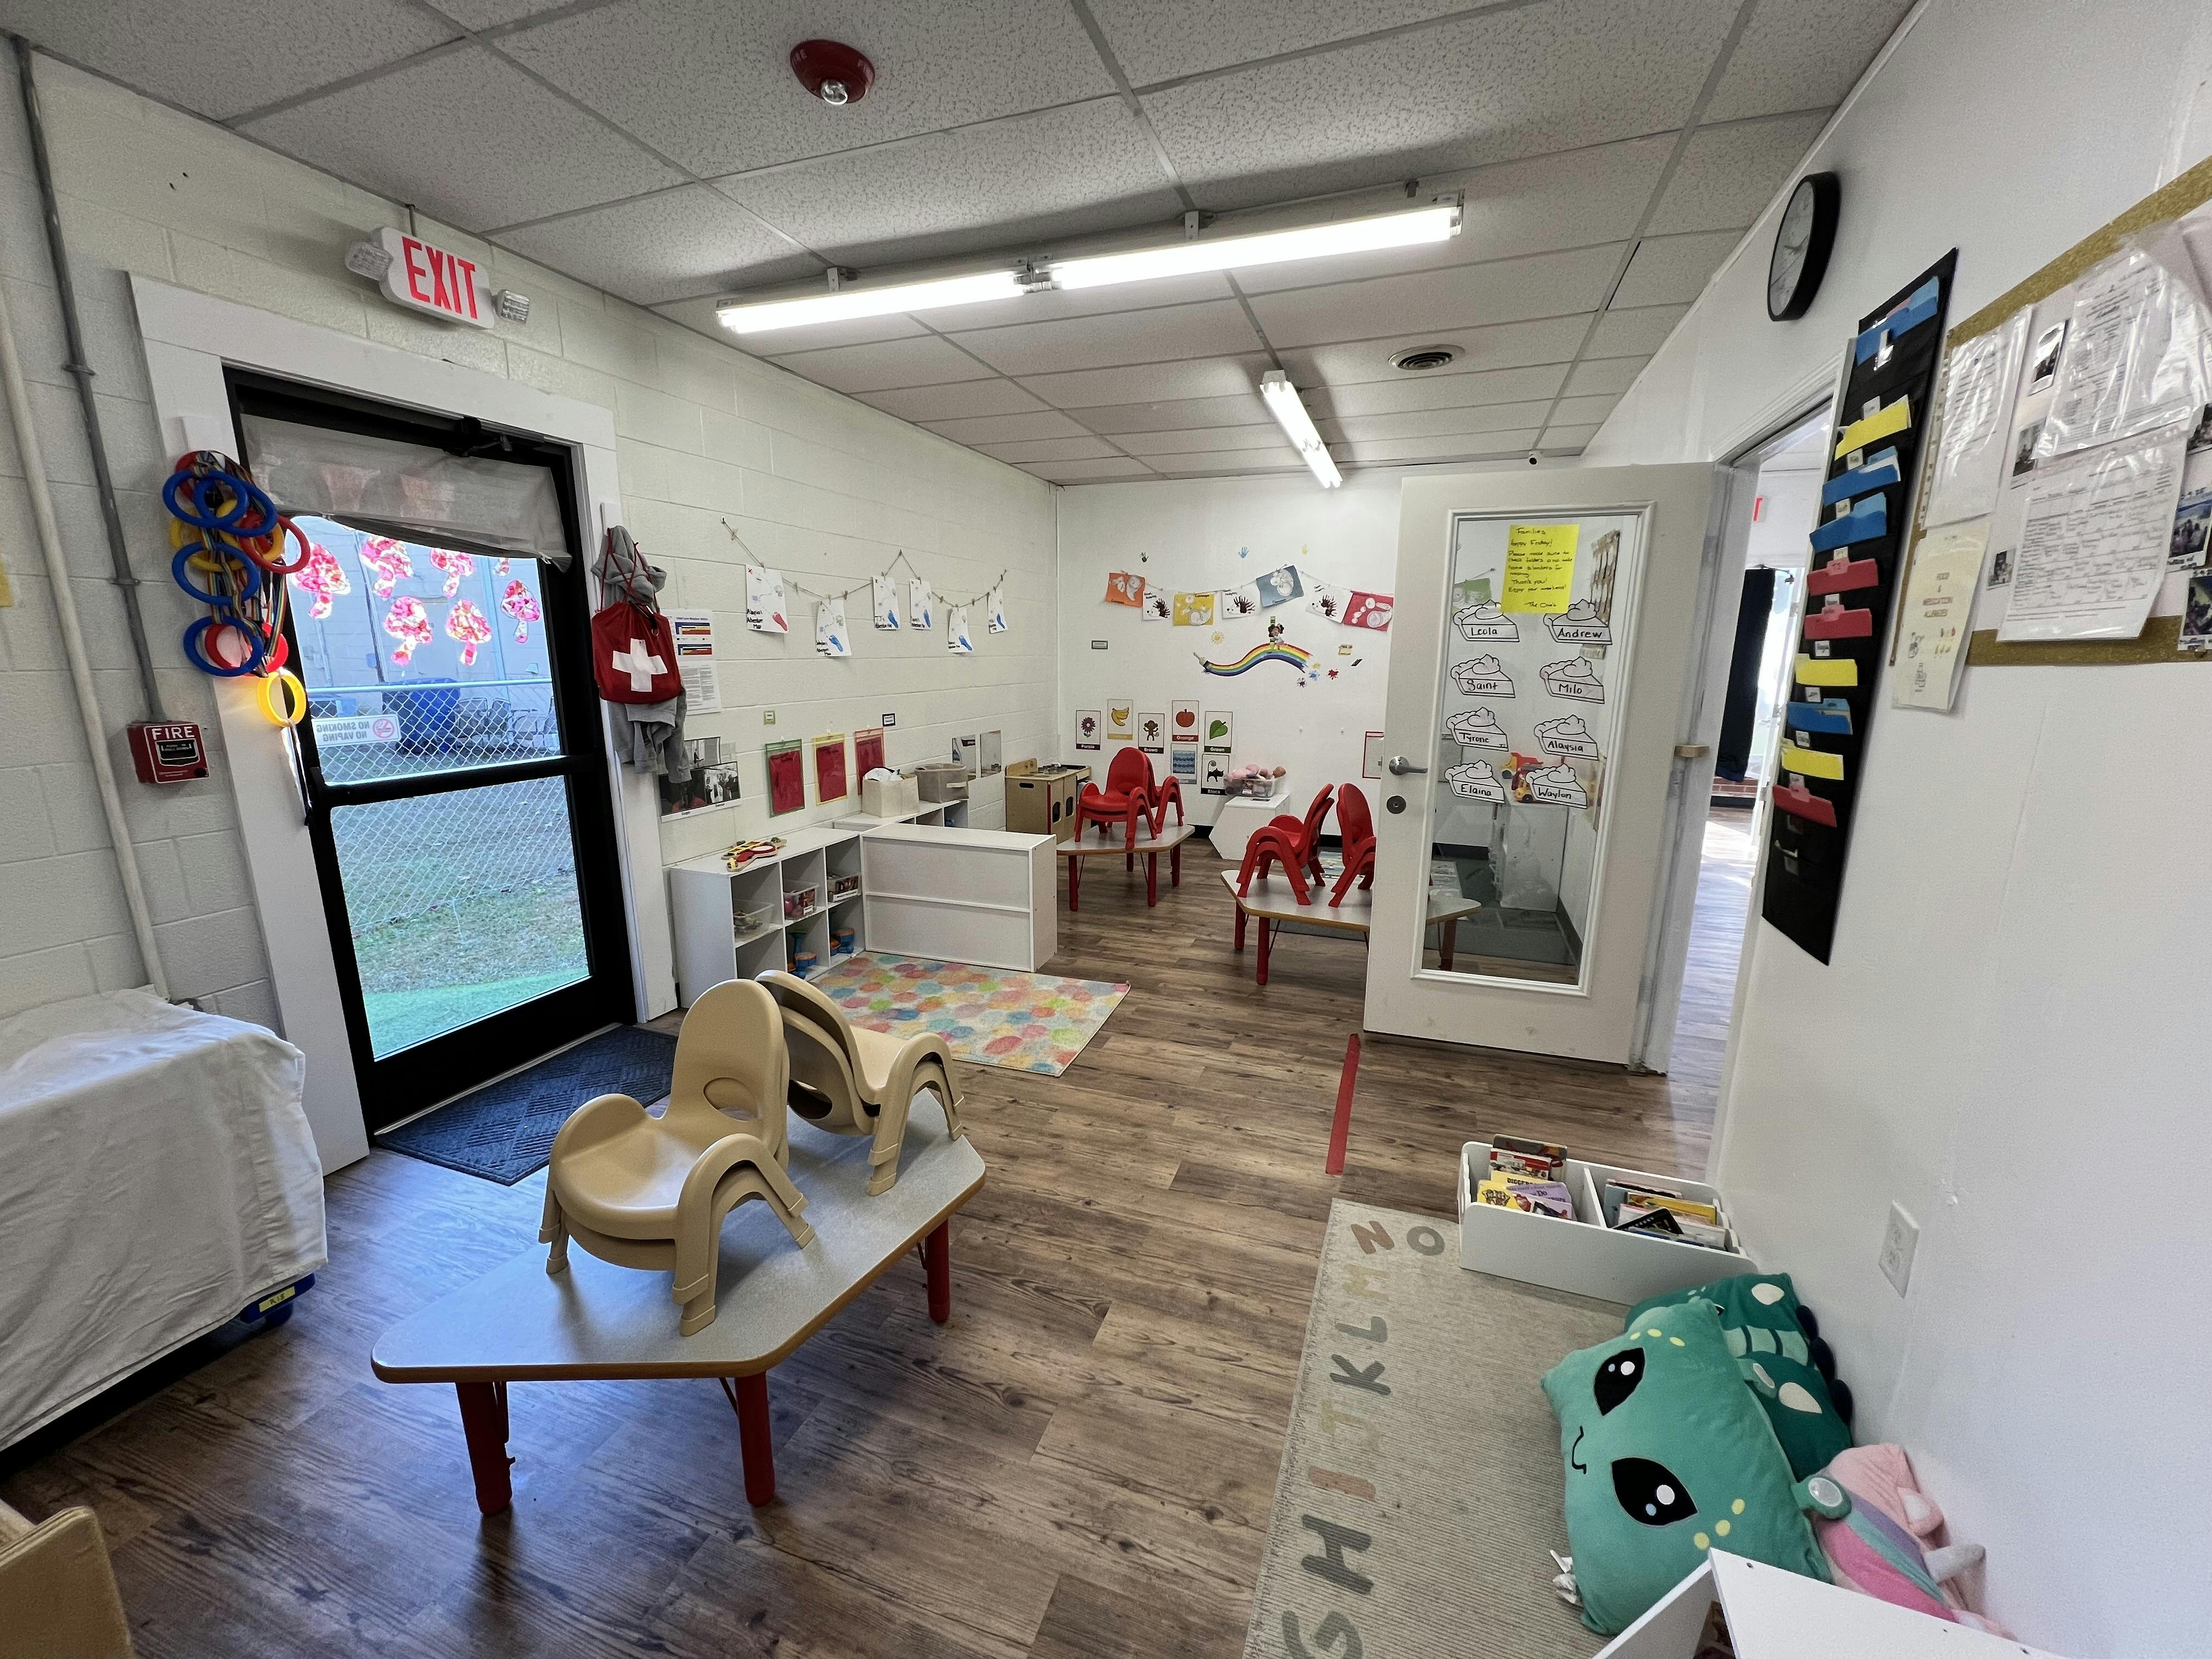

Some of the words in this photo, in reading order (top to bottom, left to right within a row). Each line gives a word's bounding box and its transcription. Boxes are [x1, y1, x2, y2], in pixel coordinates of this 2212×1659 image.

[402, 235, 477, 319] EXIT
[1471, 627, 1498, 636] Leola
[1558, 628, 1602, 638] Andrew
[1466, 679, 1498, 691] Saint
[1559, 684, 1582, 694] Milo
[152, 726, 195, 740] FIRE
[1459, 732, 1489, 743] Tyrone
[1548, 741, 1583, 752] Alaysia
[1461, 784, 1492, 797] Elaina
[1538, 787, 1571, 799] Waylon
[1350, 1221, 1395, 1255] N
[1407, 1226, 1445, 1256] O
[1342, 1263, 1390, 1300] M
[1334, 1316, 1388, 1343] L
[1330, 1353, 1391, 1396] K
[1301, 1514, 1374, 1594] H
